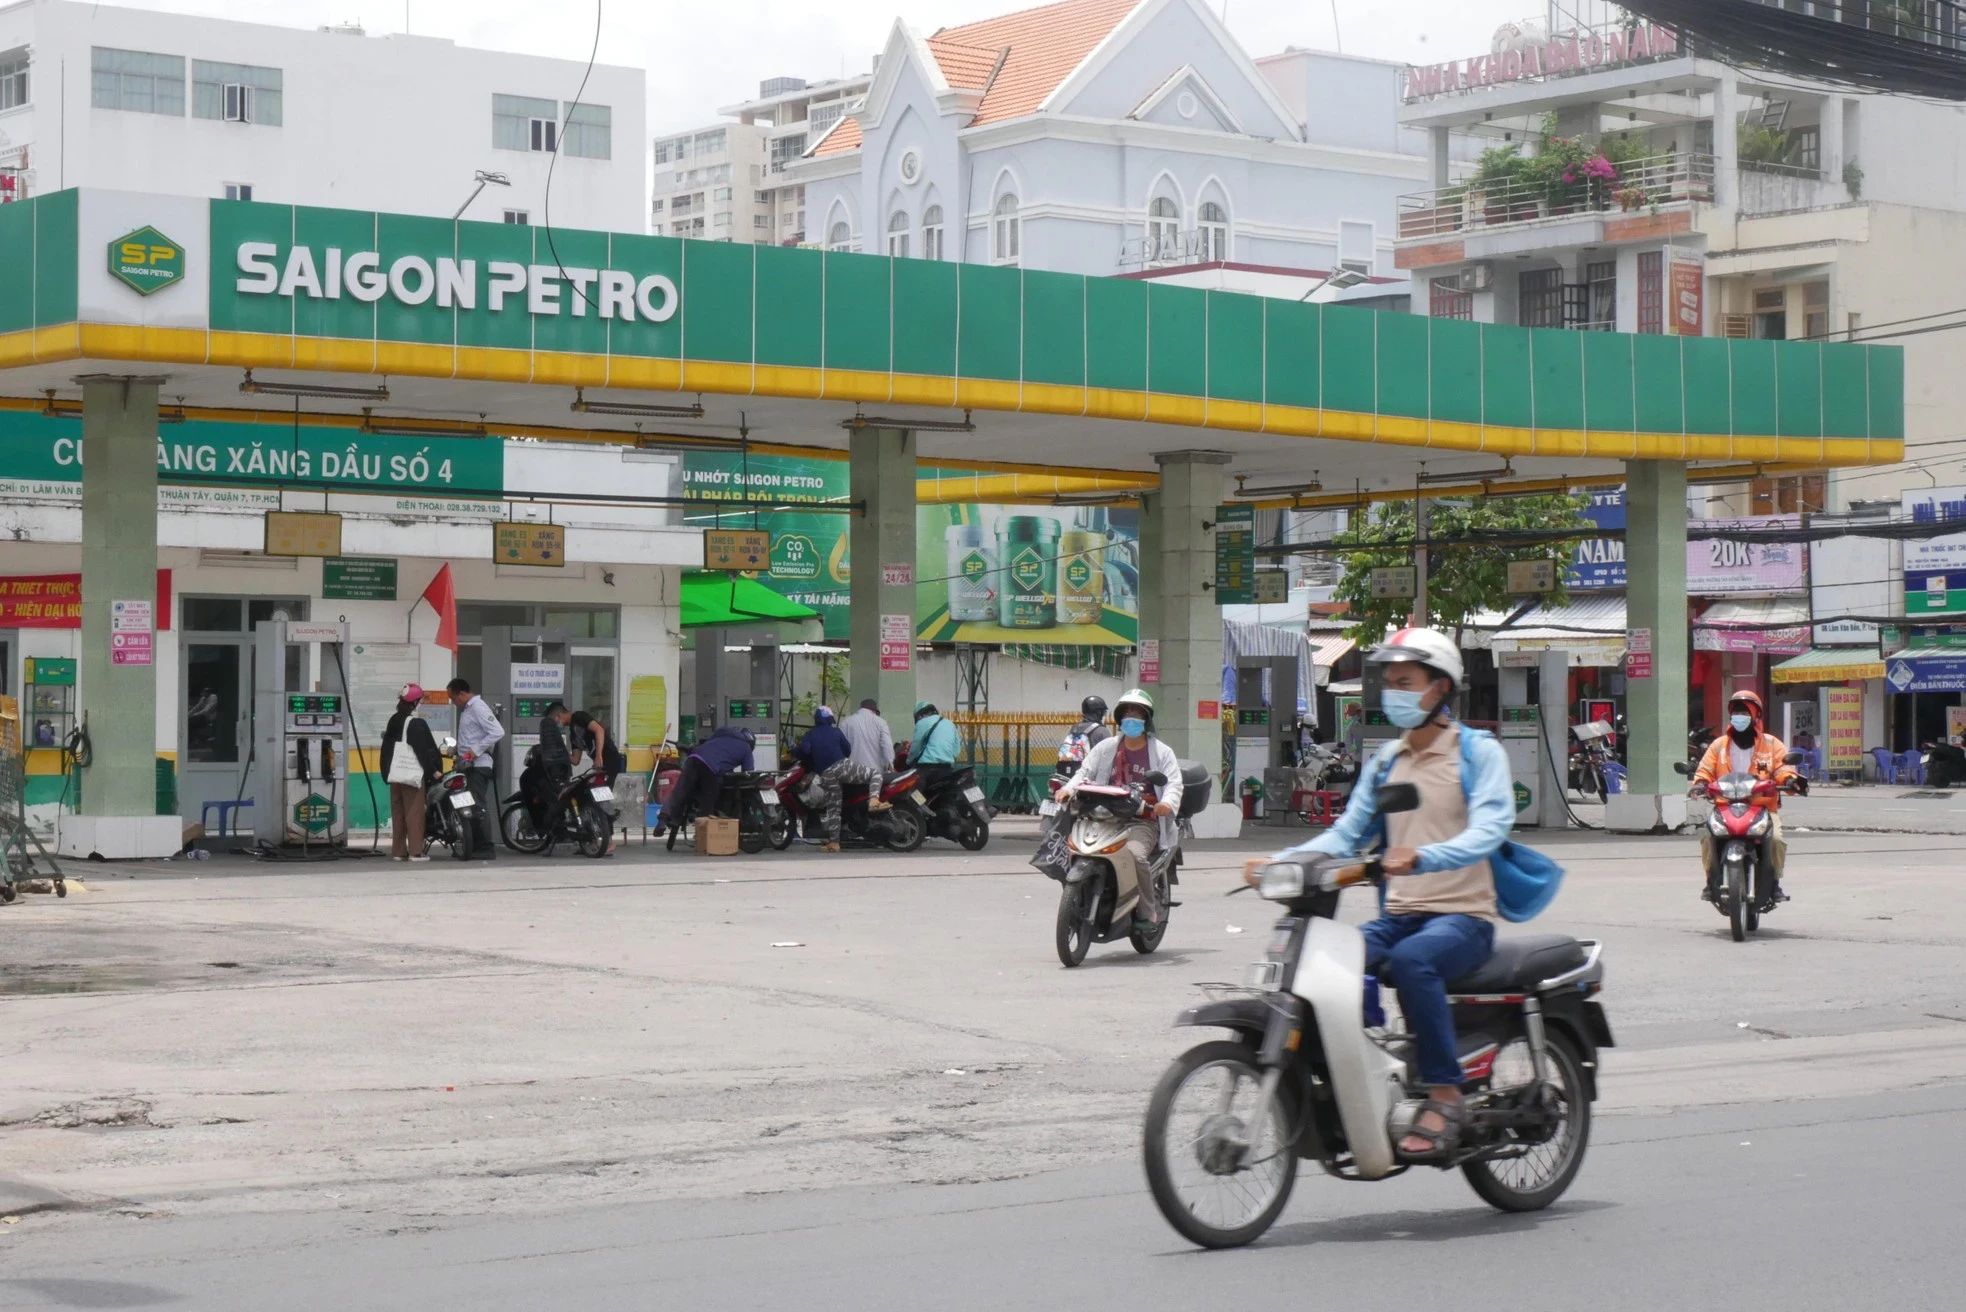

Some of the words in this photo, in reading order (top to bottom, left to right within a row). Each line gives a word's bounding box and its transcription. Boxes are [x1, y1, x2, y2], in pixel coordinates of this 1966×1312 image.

[1466, 45, 1541, 87] KHOA
[1609, 23, 1677, 63] NAM
[121, 243, 175, 265] SP
[121, 266, 148, 276] SAIGON
[149, 269, 174, 278] PETRO
[236, 241, 477, 310] SAIGON
[488, 261, 678, 322] PETRO
[158, 436, 217, 472] ÀNG
[226, 441, 311, 477] XĂNG
[322, 443, 381, 480] DẦU
[390, 446, 429, 482] SỐ
[438, 459, 453, 483] 4
[694, 469, 730, 484] NHỚT
[734, 473, 780, 487] SAIGON
[784, 476, 823, 489] PETRO
[33, 483, 52, 494] LÂM
[54, 484, 74, 495] VĂN
[161, 490, 190, 502] THUẬN
[214, 493, 239, 503] QUẬN
[397, 501, 416, 511] ĐIỆN
[418, 502, 445, 512] THOẠI:
[1578, 539, 1625, 564] NAM
[1710, 538, 1751, 568] 20K
[772, 566, 814, 574] TECHNOLOGY
[966, 561, 983, 572] SP
[1020, 562, 1037, 573] SP
[1070, 567, 1086, 577] SP
[885, 573, 910, 583] 24/24
[1942, 679, 1964, 689] THUỐC
[1796, 716, 1813, 729] 20K
[300, 805, 330, 817] SP
